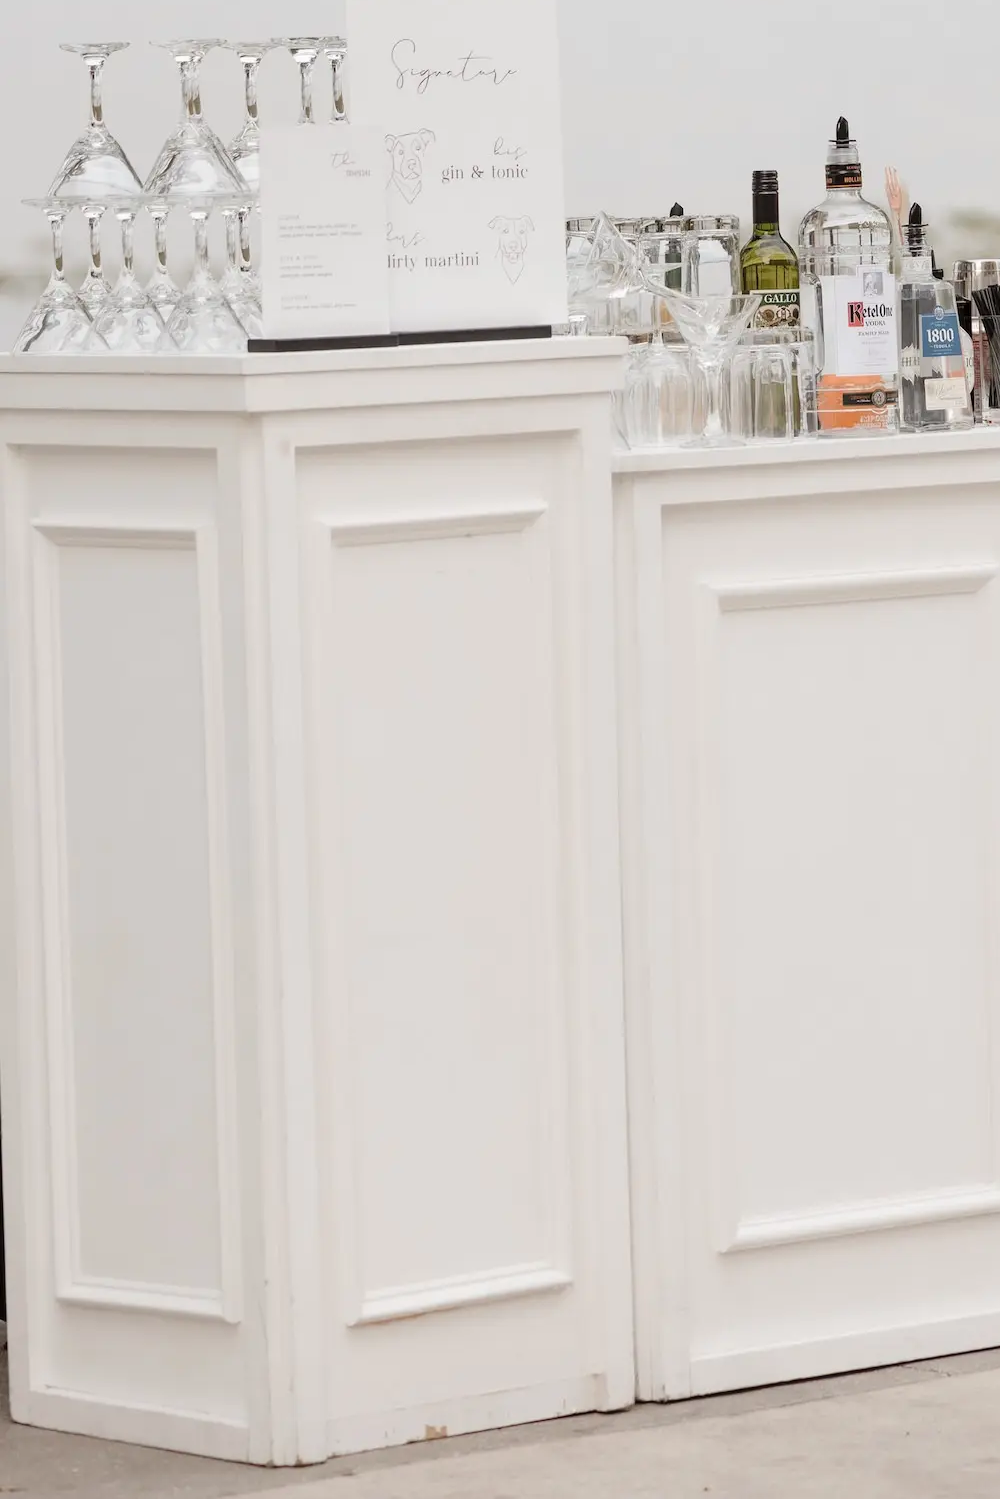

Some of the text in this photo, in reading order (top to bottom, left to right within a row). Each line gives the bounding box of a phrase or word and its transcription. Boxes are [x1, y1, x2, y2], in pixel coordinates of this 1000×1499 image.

[391, 38, 518, 94] Signature
[441, 164, 529, 184] gin & tonic
[387, 251, 480, 272] irty martini
[764, 293, 797, 304] GALLO
[849, 303, 879, 325] Ketel
[926, 328, 954, 343] 1800
